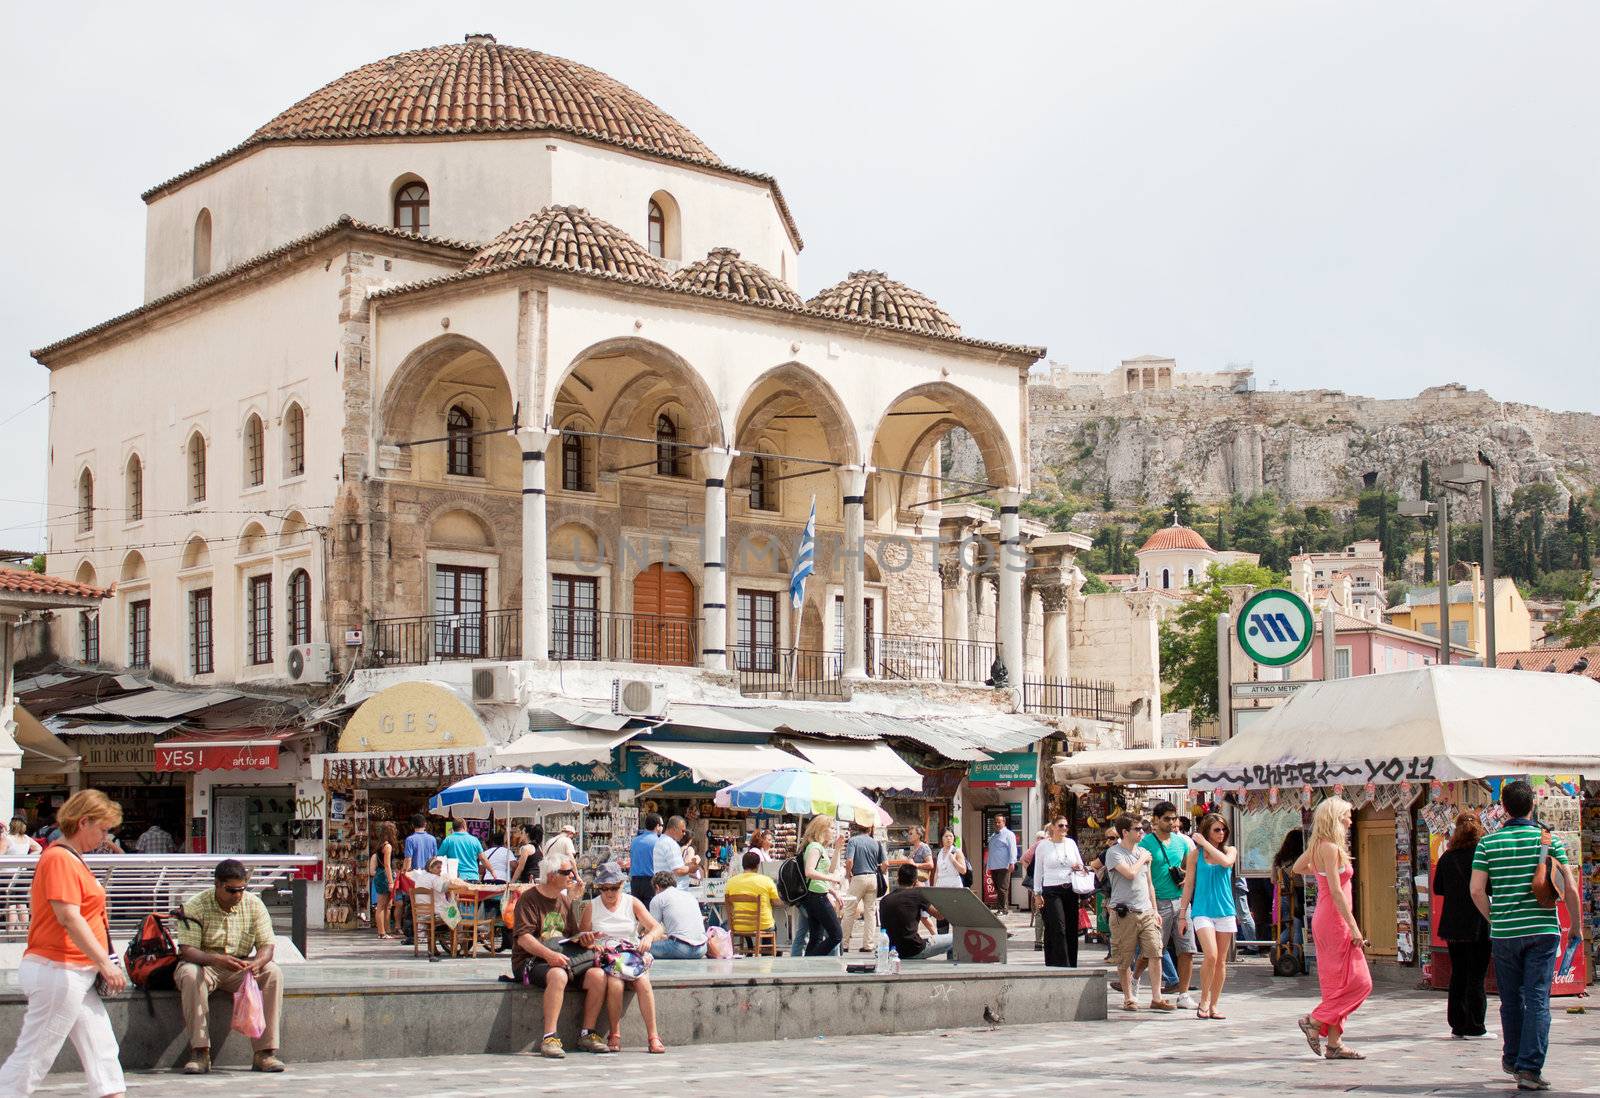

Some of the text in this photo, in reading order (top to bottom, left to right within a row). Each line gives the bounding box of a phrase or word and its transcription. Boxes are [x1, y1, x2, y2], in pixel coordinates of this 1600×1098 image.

[379, 711, 438, 733] GES
[232, 756, 270, 766] art for all
[982, 763, 1020, 772] eurochange
